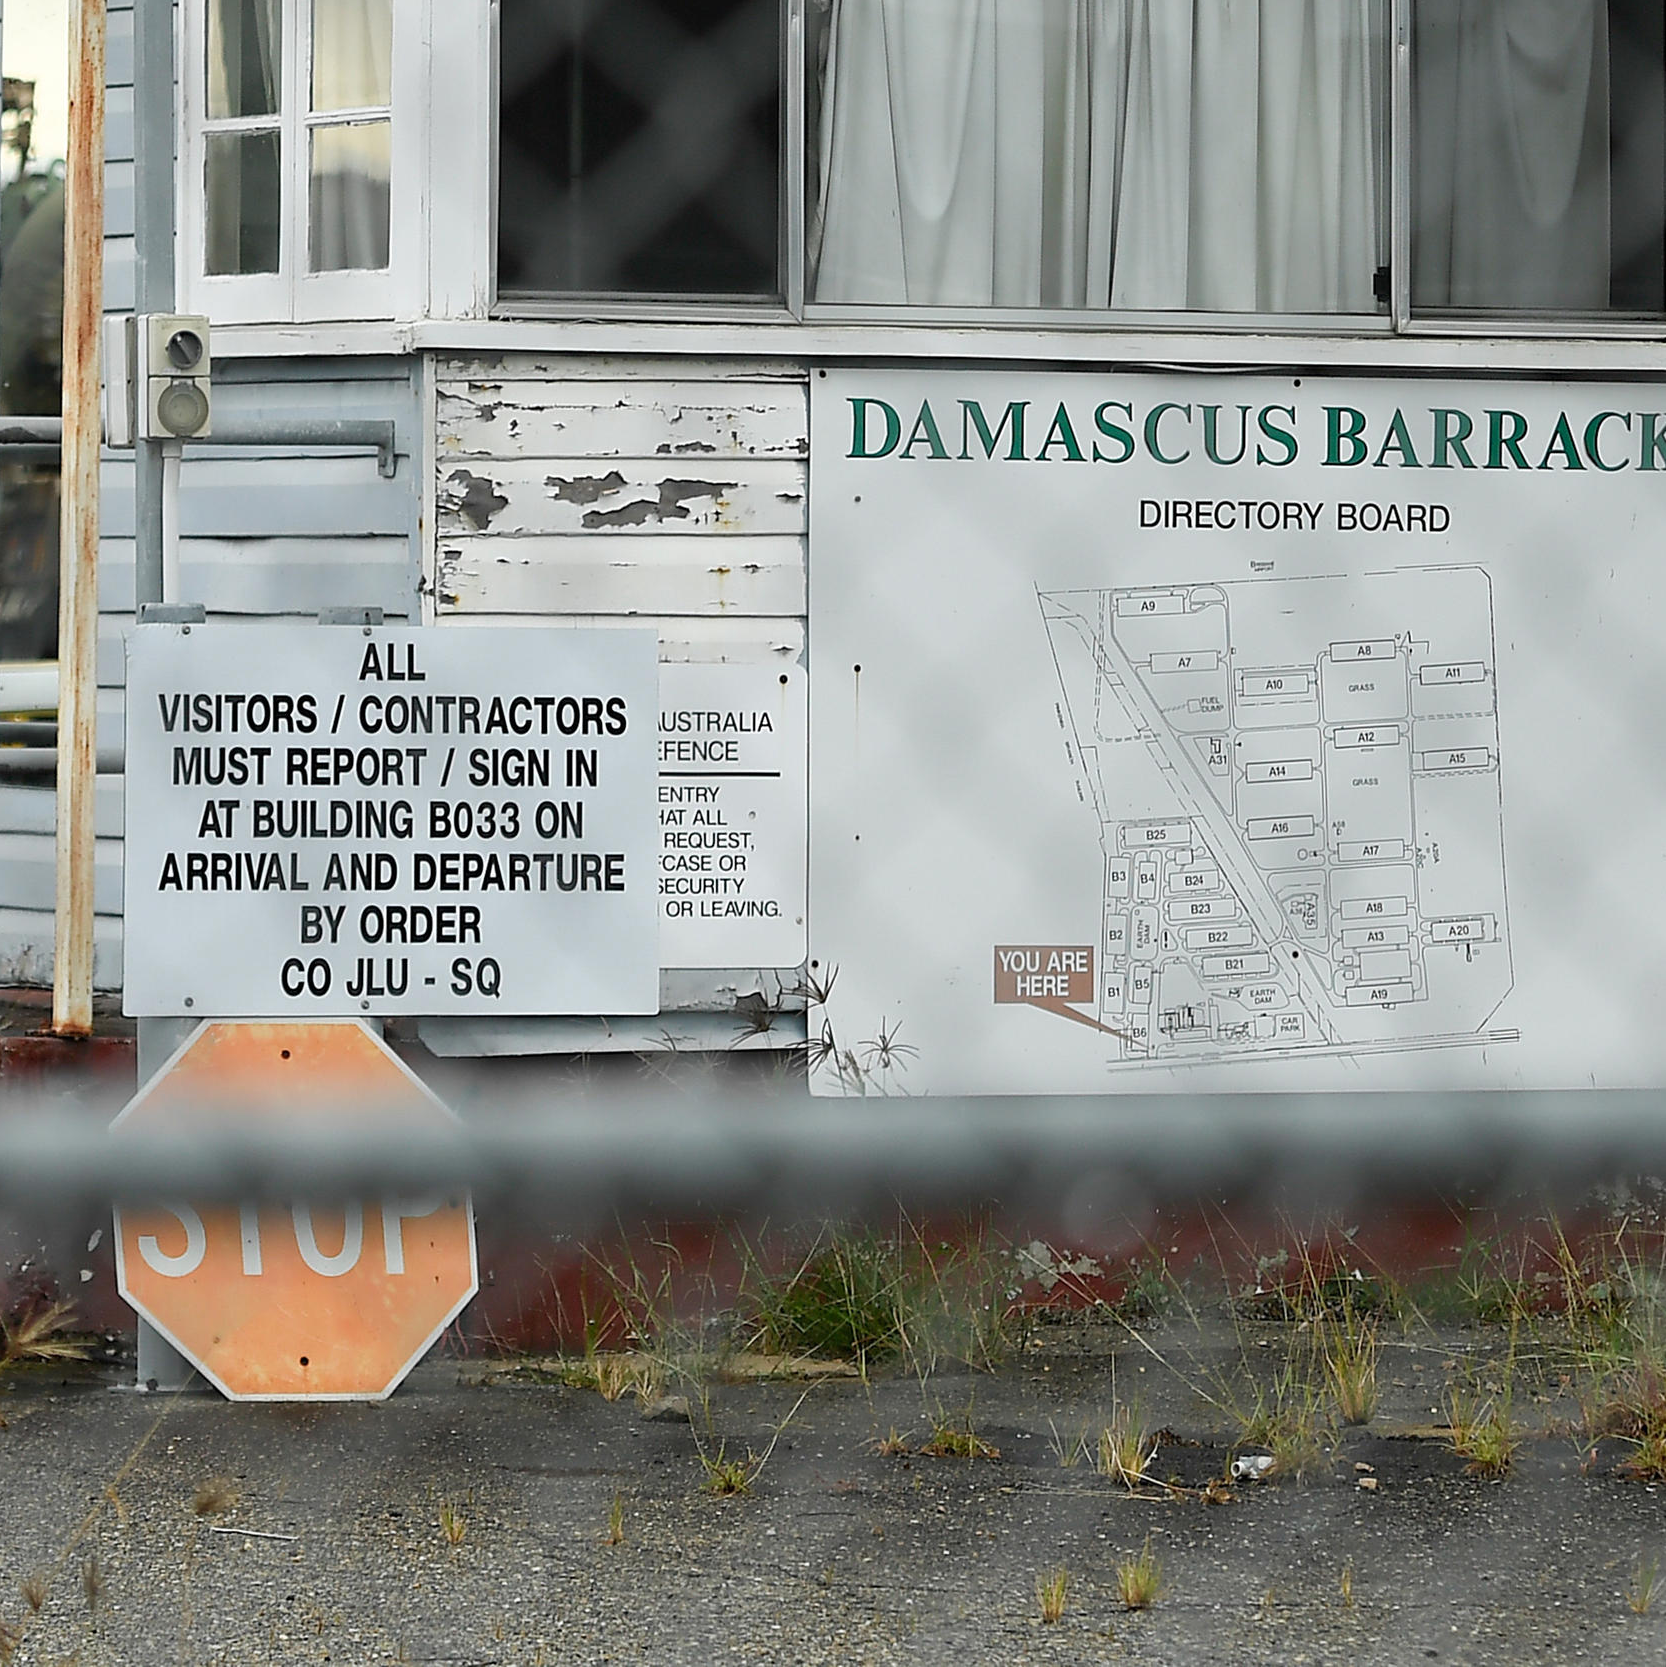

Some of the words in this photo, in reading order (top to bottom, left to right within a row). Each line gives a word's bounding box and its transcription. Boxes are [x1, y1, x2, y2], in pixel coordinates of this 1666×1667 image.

[845, 397, 1299, 467] DAMASCUS
[1139, 499, 1324, 532] DIRECTORY
[1337, 502, 1451, 533] BOARD
[1141, 601, 1156, 612] A9
[1357, 645, 1371, 656] A8
[359, 644, 426, 680] ALL
[1178, 657, 1191, 668] A7
[1445, 667, 1461, 678] A11
[1266, 679, 1283, 690] A10
[1349, 684, 1375, 692] GRASS
[1201, 697, 1220, 705] FUEL
[1201, 704, 1224, 713] DUMP
[159, 695, 317, 733] VISITORS
[360, 695, 627, 735] CONTRACTORS
[1358, 731, 1374, 742] A12
[658, 741, 738, 761] FENCE
[1208, 755, 1227, 765] A31
[1449, 753, 1466, 764] A15
[173, 747, 271, 785] MUST
[286, 747, 427, 786] REPORT
[469, 748, 555, 786] SIGN
[566, 750, 598, 787] IN
[1268, 766, 1286, 777] A14
[1352, 778, 1379, 786] GRASS
[658, 787, 720, 802] ENTRY
[198, 800, 239, 838] AT
[253, 800, 412, 838] BUILDING
[430, 801, 520, 838] B033
[535, 802, 583, 839] ON
[693, 810, 728, 825] ALL
[1271, 822, 1289, 833] A16
[1146, 830, 1166, 840] B25
[664, 832, 754, 851] REQUEST,
[1363, 845, 1379, 856] A17
[658, 855, 712, 871] CASE
[719, 855, 746, 871] OR
[158, 853, 308, 890] ARRIVAL
[323, 853, 397, 891] AND
[414, 853, 625, 892] DEPARTURE
[1112, 871, 1126, 882] B3
[1140, 873, 1155, 884] B4
[1185, 875, 1204, 886] B24
[666, 901, 693, 917] OR
[701, 901, 782, 917] LEAVING.
[1190, 903, 1211, 914] B23
[1366, 902, 1383, 913] A18
[1307, 902, 1316, 926] A35
[301, 906, 344, 943] BY
[360, 906, 481, 943] ORDER
[1109, 930, 1123, 940] B2
[1449, 925, 1469, 936] A20
[1208, 932, 1228, 942] B22
[1367, 931, 1384, 942] A13
[999, 951, 1041, 972] YOU
[1047, 951, 1088, 972] ARE
[1225, 959, 1244, 969] B21
[282, 958, 331, 996] CO
[347, 958, 409, 997] JLU
[451, 958, 501, 999] SQ
[1135, 979, 1149, 989] B5
[1016, 975, 1069, 996] HERE
[1108, 987, 1120, 997] B1
[1250, 989, 1276, 998] EARTH
[1370, 989, 1388, 1000] A19
[1254, 996, 1272, 1004] DAM
[1281, 1017, 1298, 1025] CAR
[1133, 1027, 1146, 1037] B6
